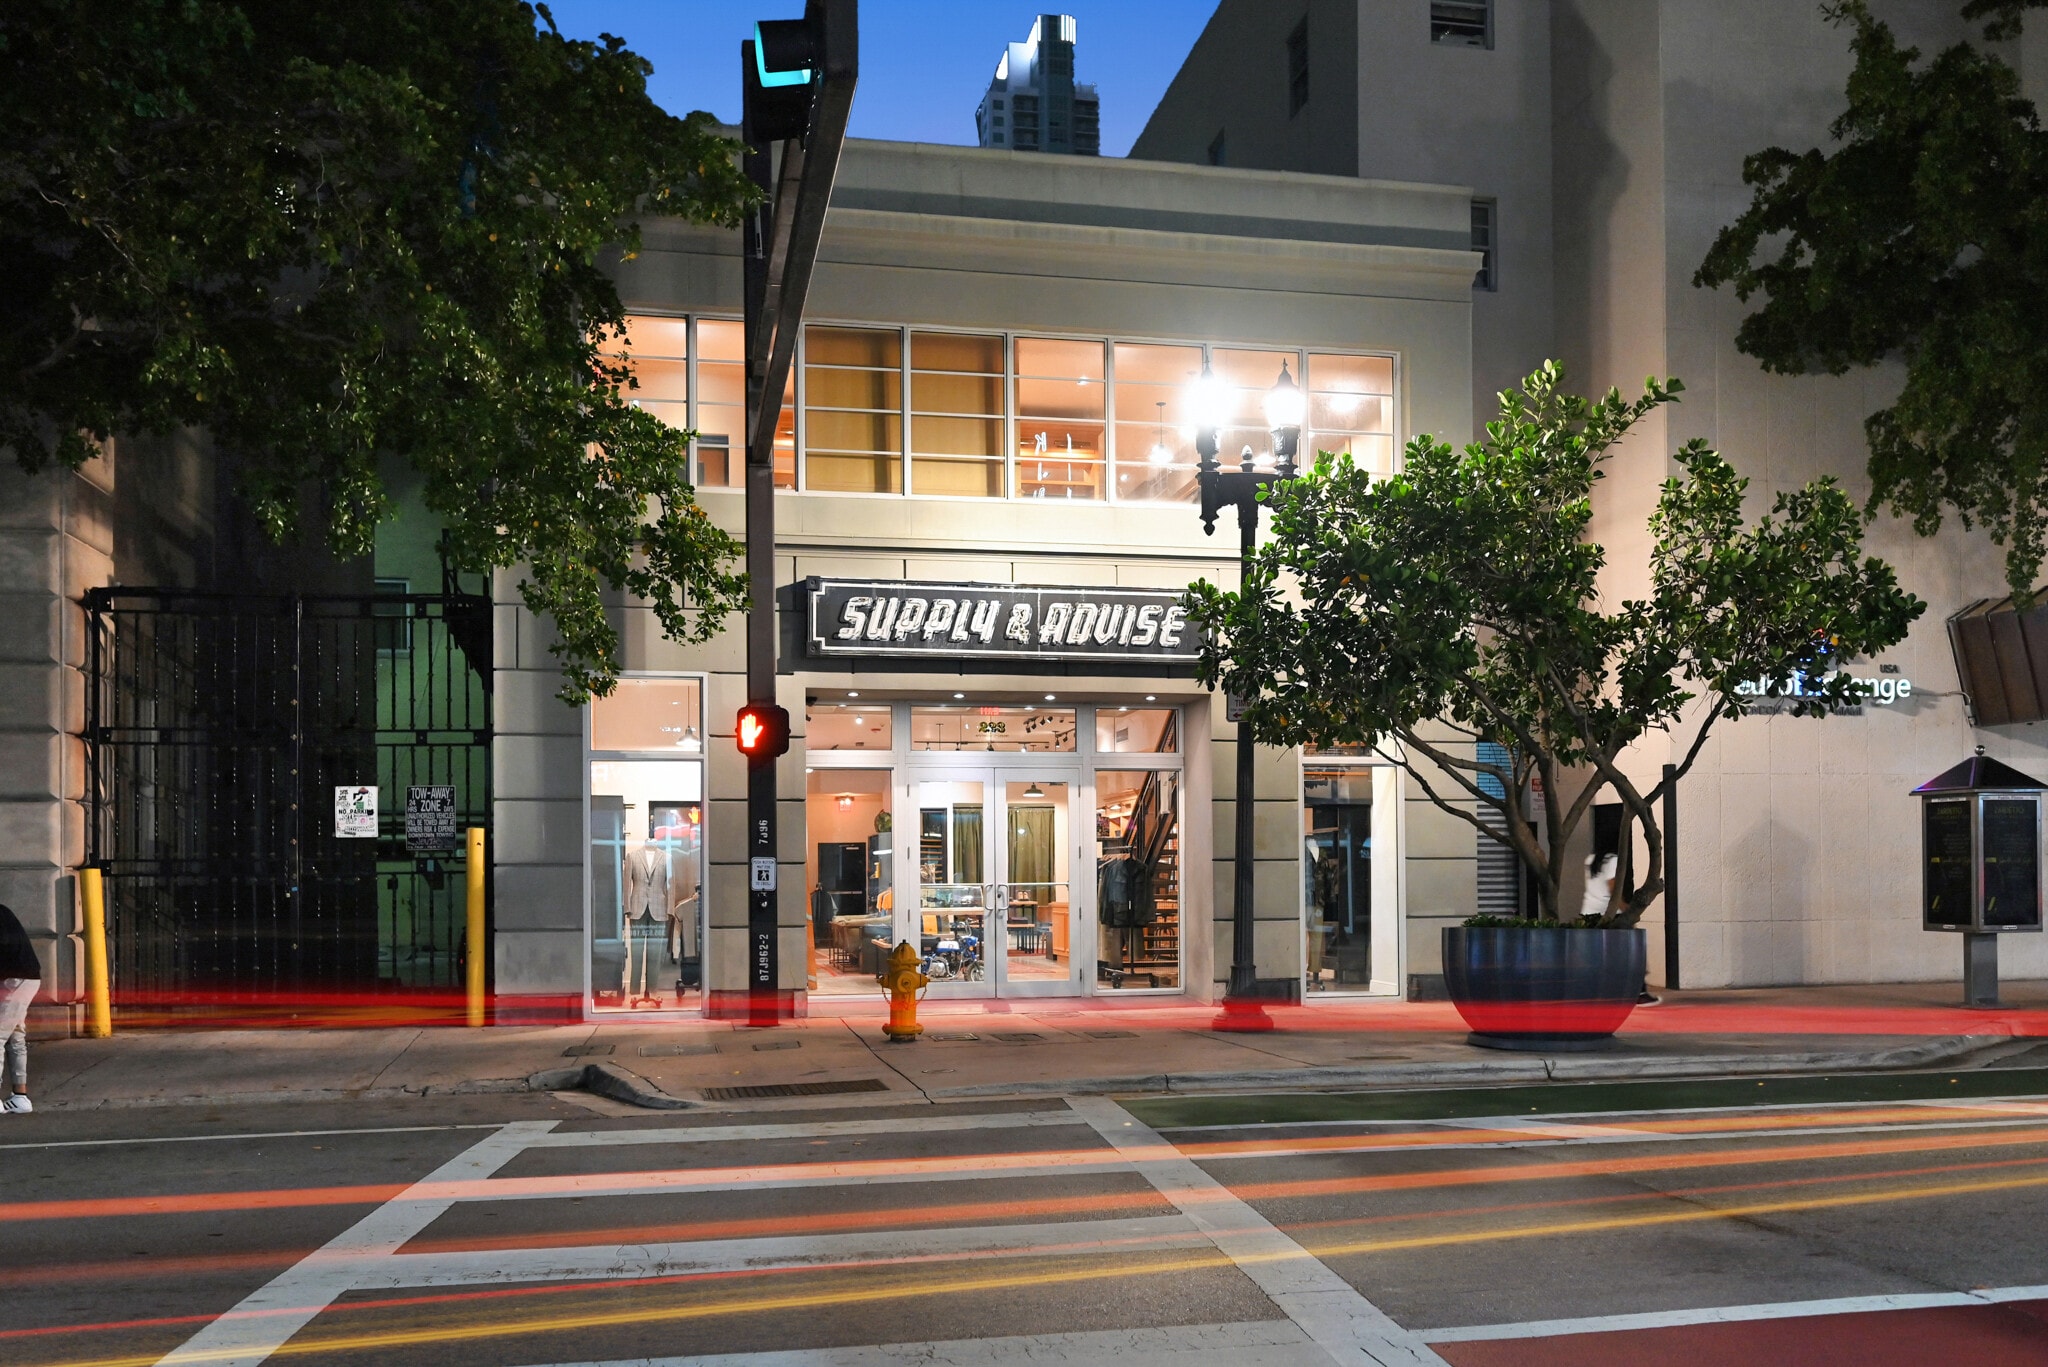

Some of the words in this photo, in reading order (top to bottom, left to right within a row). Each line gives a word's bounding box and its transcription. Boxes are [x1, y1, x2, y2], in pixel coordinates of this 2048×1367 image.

[836, 596, 1000, 642] SUPPLY
[1006, 603, 1033, 645] &
[1039, 602, 1188, 647] ADVISE
[1880, 664, 1899, 673] USA
[411, 787, 450, 799] TOW-AWAY
[421, 800, 441, 812] ZONE
[759, 820, 768, 844] 7J96
[759, 934, 769, 981] 87J962-2
